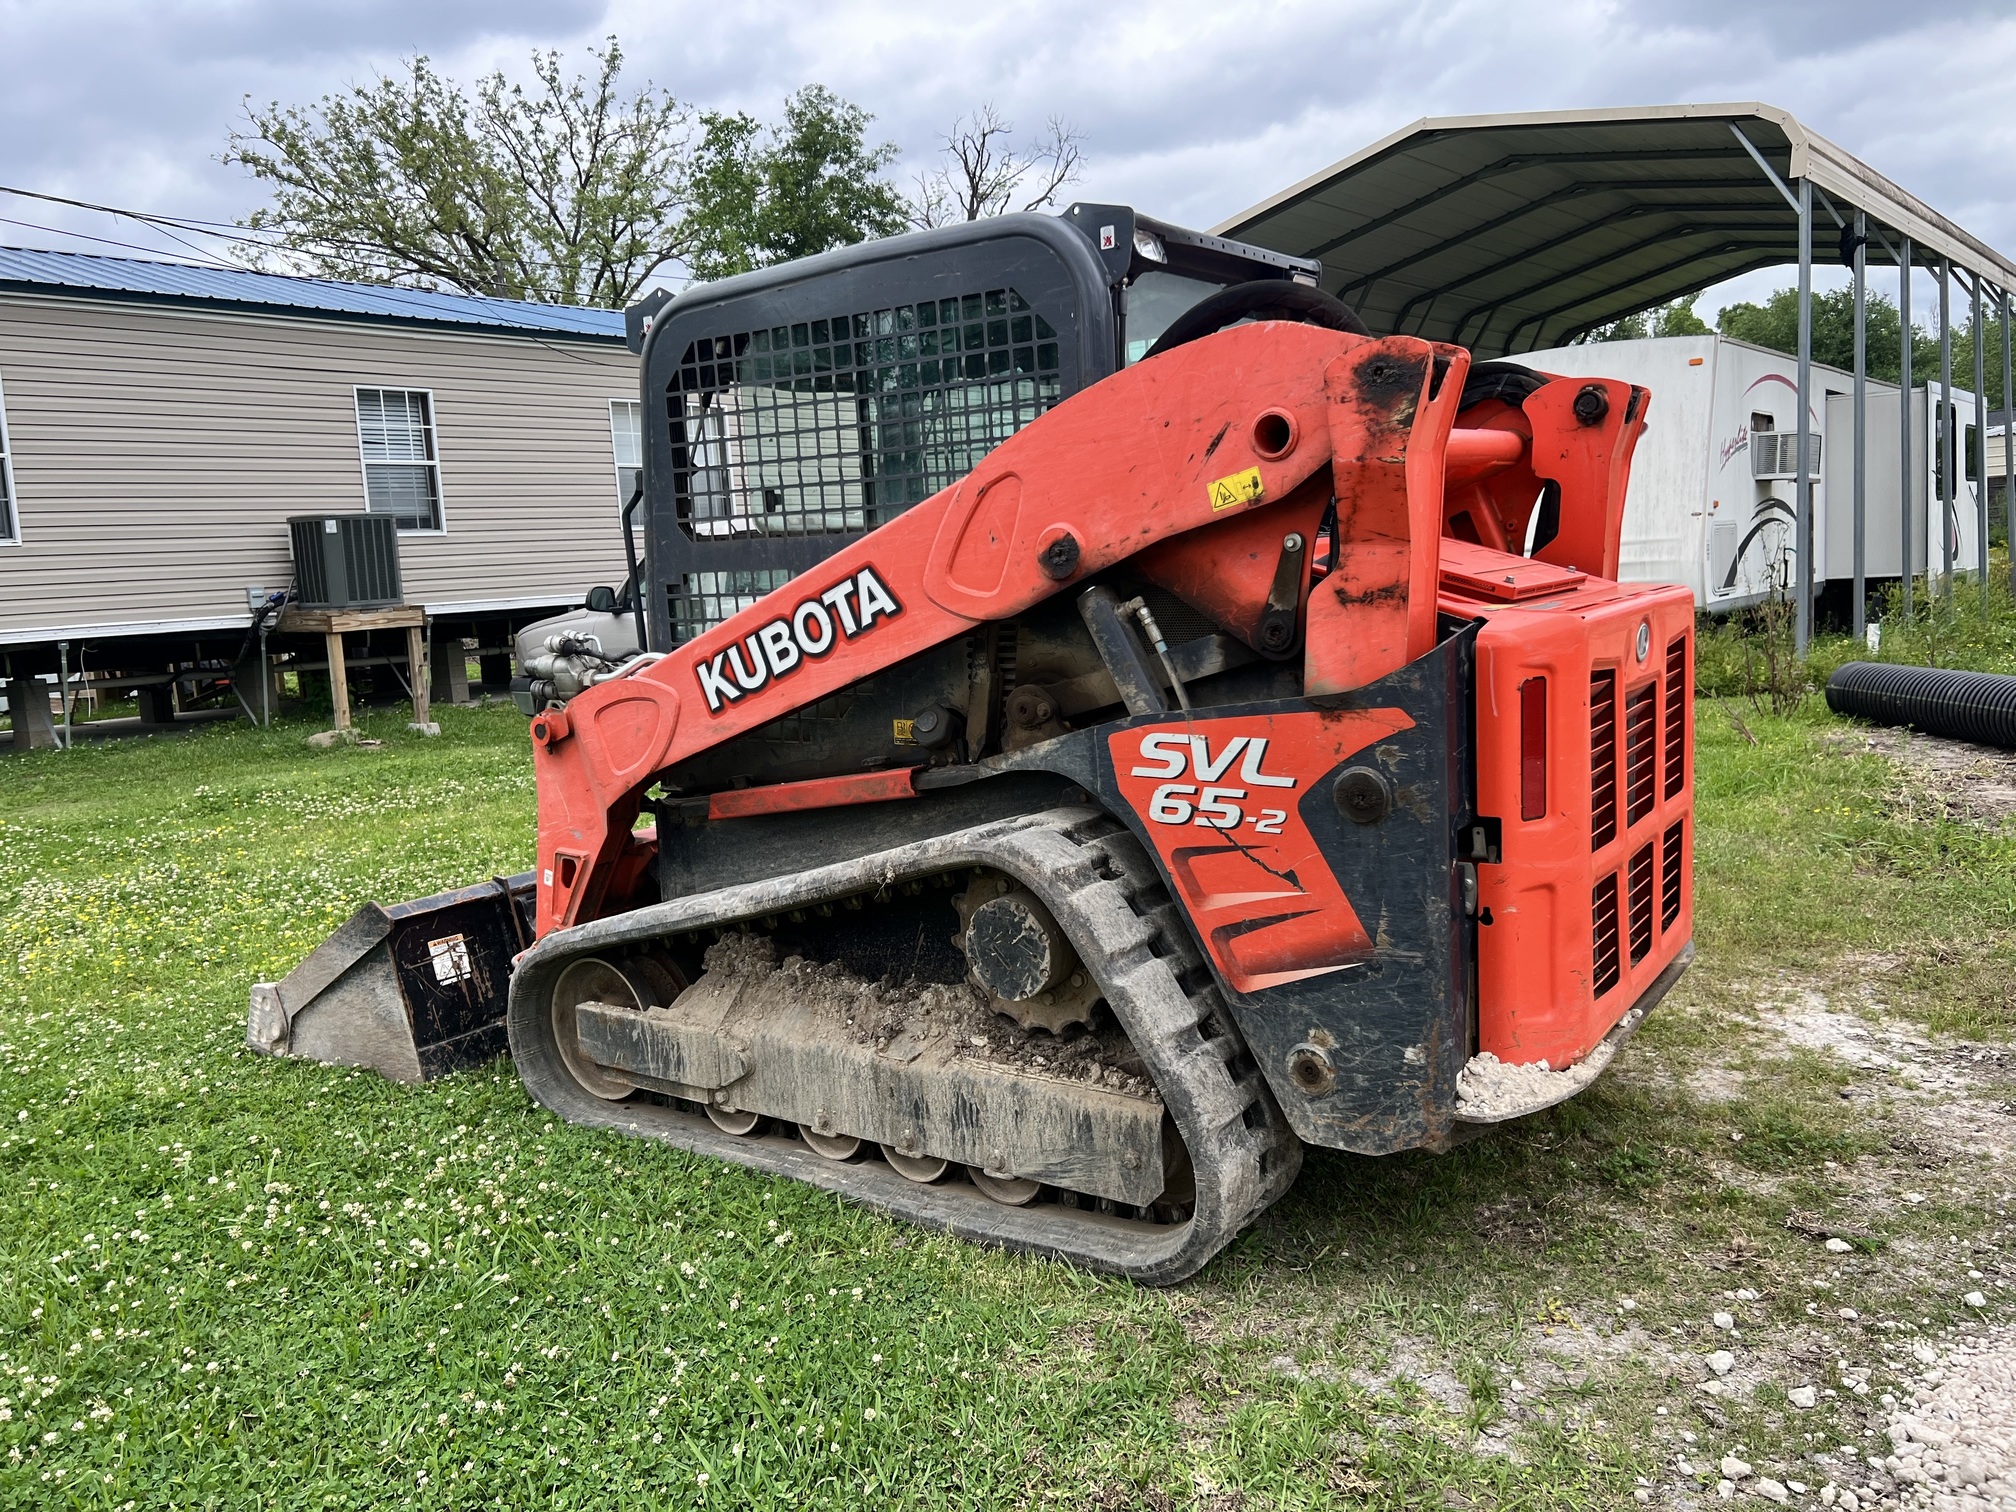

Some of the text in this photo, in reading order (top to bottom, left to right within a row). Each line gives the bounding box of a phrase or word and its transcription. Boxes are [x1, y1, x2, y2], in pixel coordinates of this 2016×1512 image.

[696, 568, 898, 713] KUBOTA
[1131, 733, 1297, 788] SVL
[1149, 784, 1287, 834] 65-2
